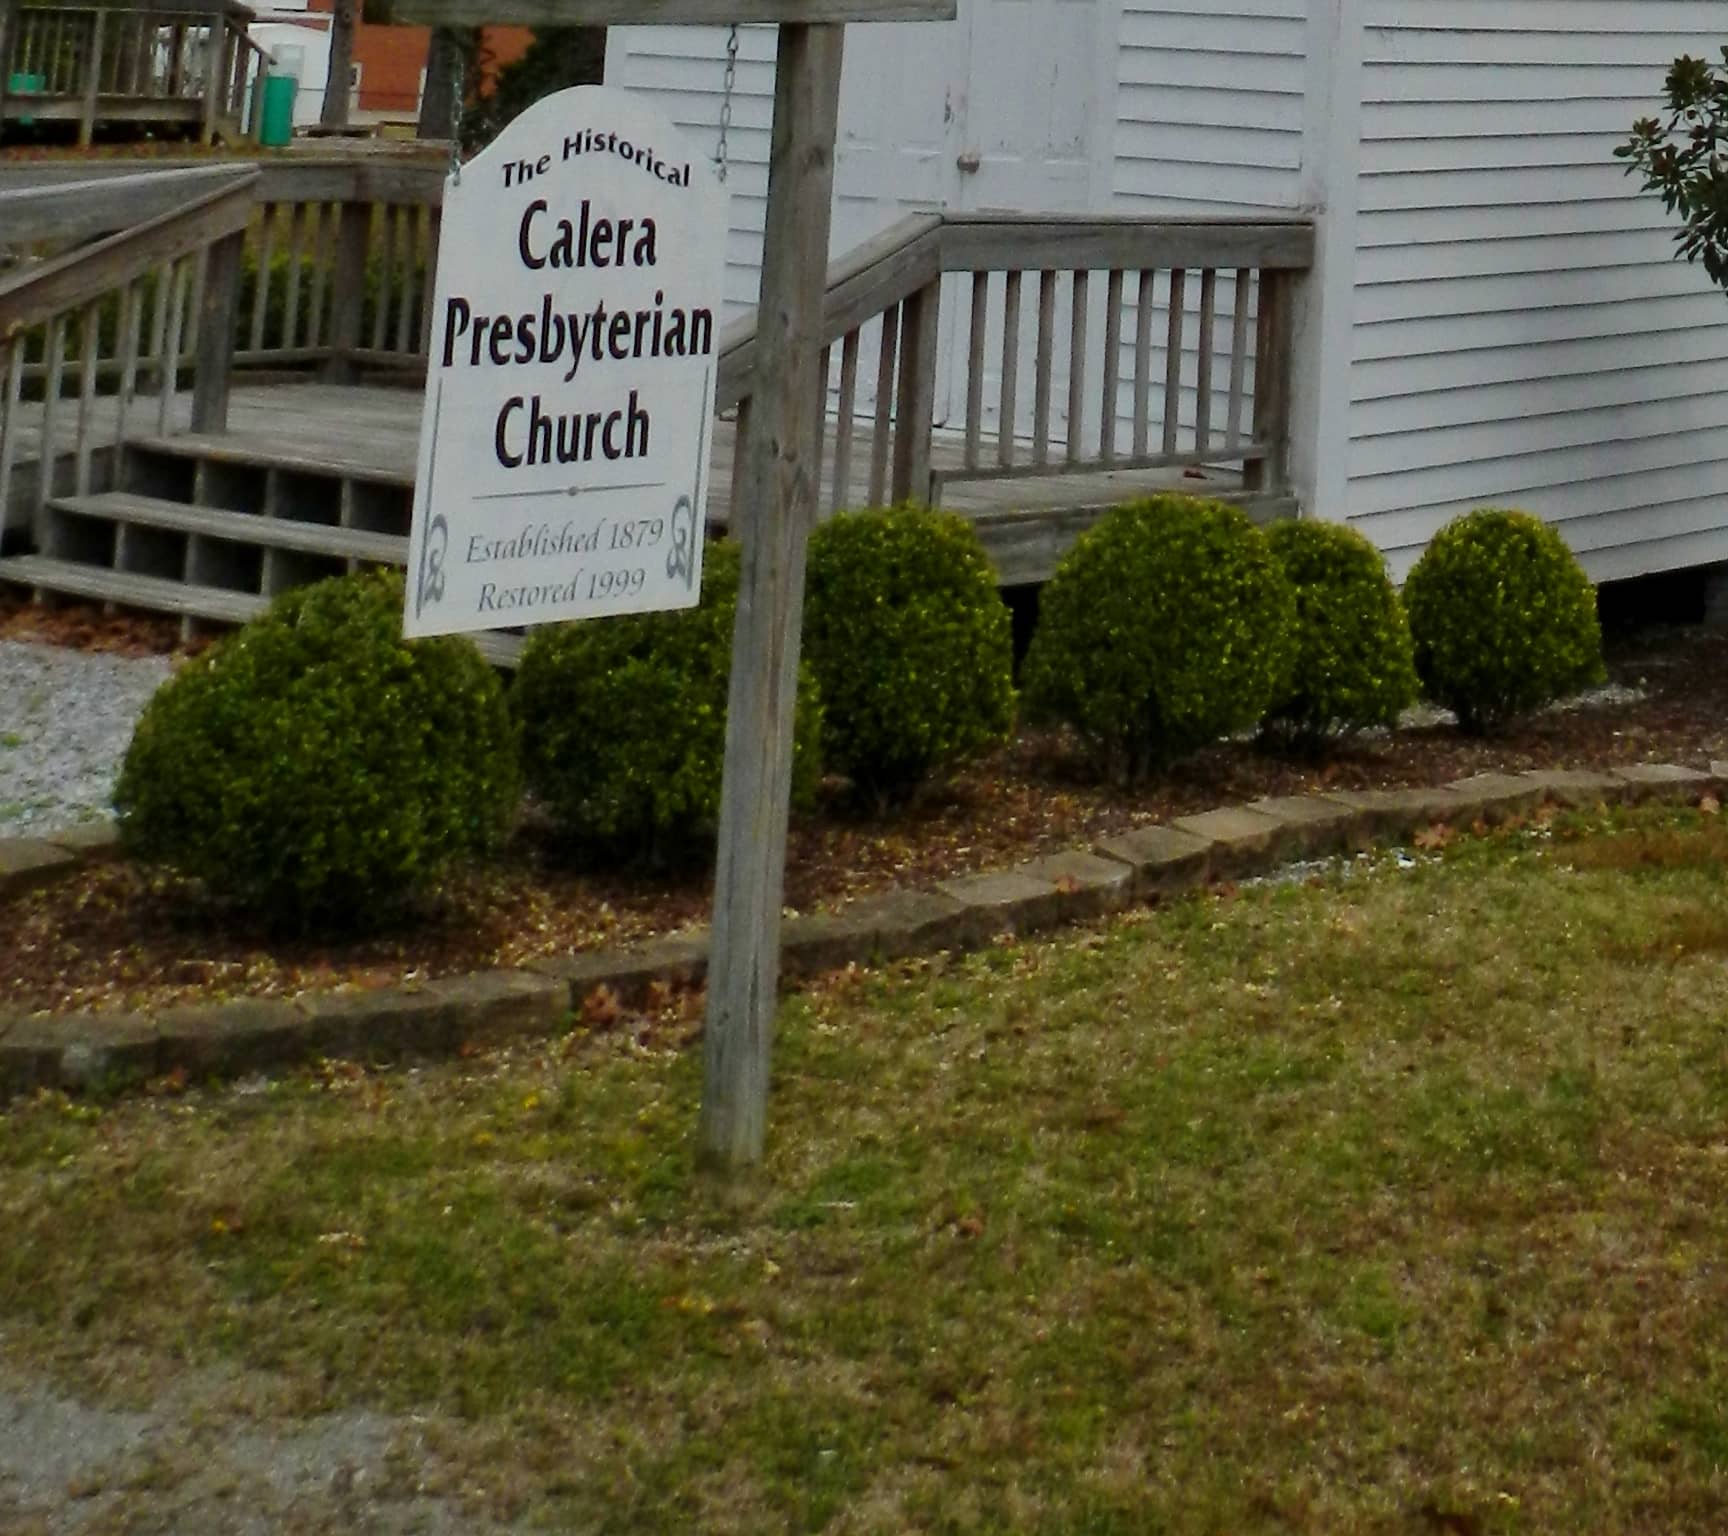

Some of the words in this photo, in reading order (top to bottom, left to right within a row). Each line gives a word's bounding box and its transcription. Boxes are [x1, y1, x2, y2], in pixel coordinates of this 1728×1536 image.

[502, 154, 551, 189] The
[563, 127, 691, 189] Historical
[519, 199, 657, 271] Calera
[442, 290, 713, 383] Presbyterian
[495, 389, 650, 469] Church
[466, 518, 606, 564] Established
[608, 517, 665, 552] 1879
[478, 568, 583, 612] Restored
[589, 567, 646, 600] 1999
